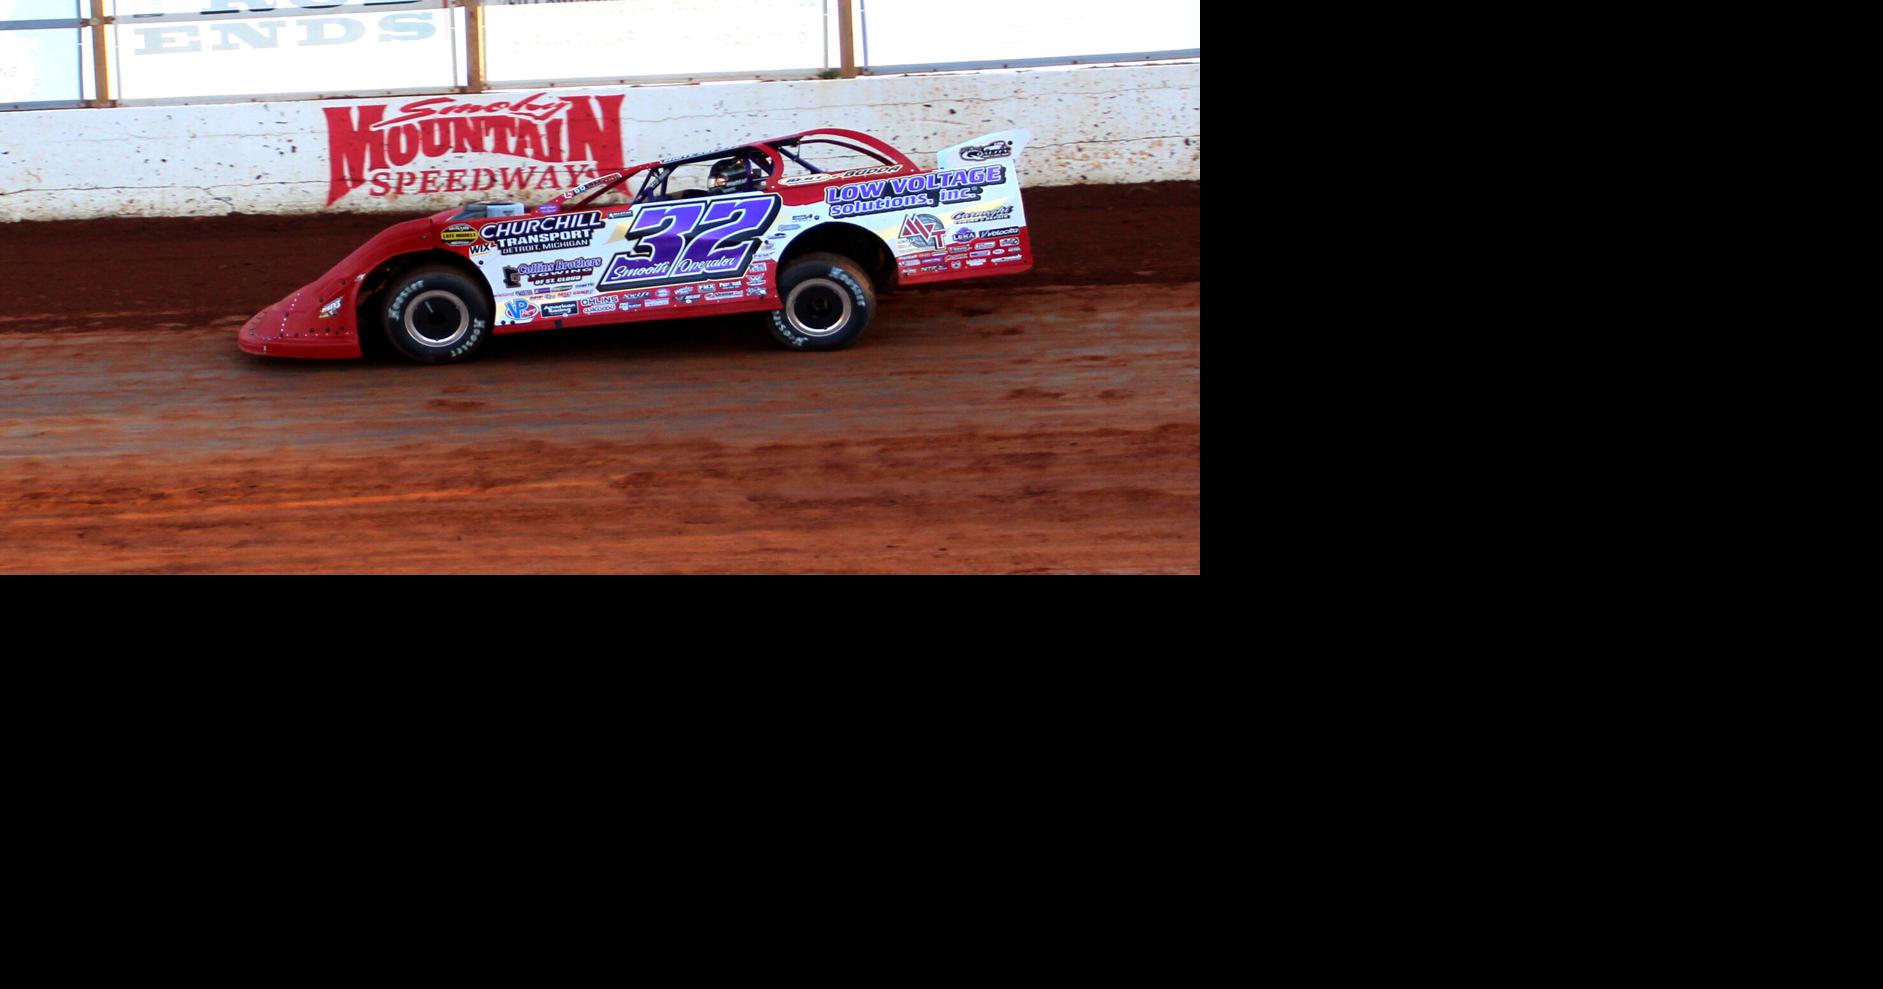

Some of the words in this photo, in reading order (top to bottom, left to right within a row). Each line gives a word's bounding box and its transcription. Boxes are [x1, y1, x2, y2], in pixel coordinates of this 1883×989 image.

[133, 12, 438, 56] ENDS
[370, 92, 572, 128] Smoky
[322, 94, 635, 208] MOUNTAIN
[369, 161, 587, 198] SPEEDWAY
[825, 181, 884, 204] LOW
[889, 164, 1003, 195] VOLTAGE
[939, 187, 976, 201] inc.
[480, 211, 602, 239] CHURCHILL
[470, 243, 490, 255] WIX
[497, 228, 592, 248] TRANSPORT
[542, 238, 589, 250] MICHIGAN
[600, 195, 776, 286] 32
[517, 261, 555, 275] Collins
[555, 257, 602, 271] Brothers
[529, 267, 593, 278] TOWING
[611, 260, 670, 280] Smooth
[680, 256, 736, 272] Operator
[506, 299, 528, 319] VP
